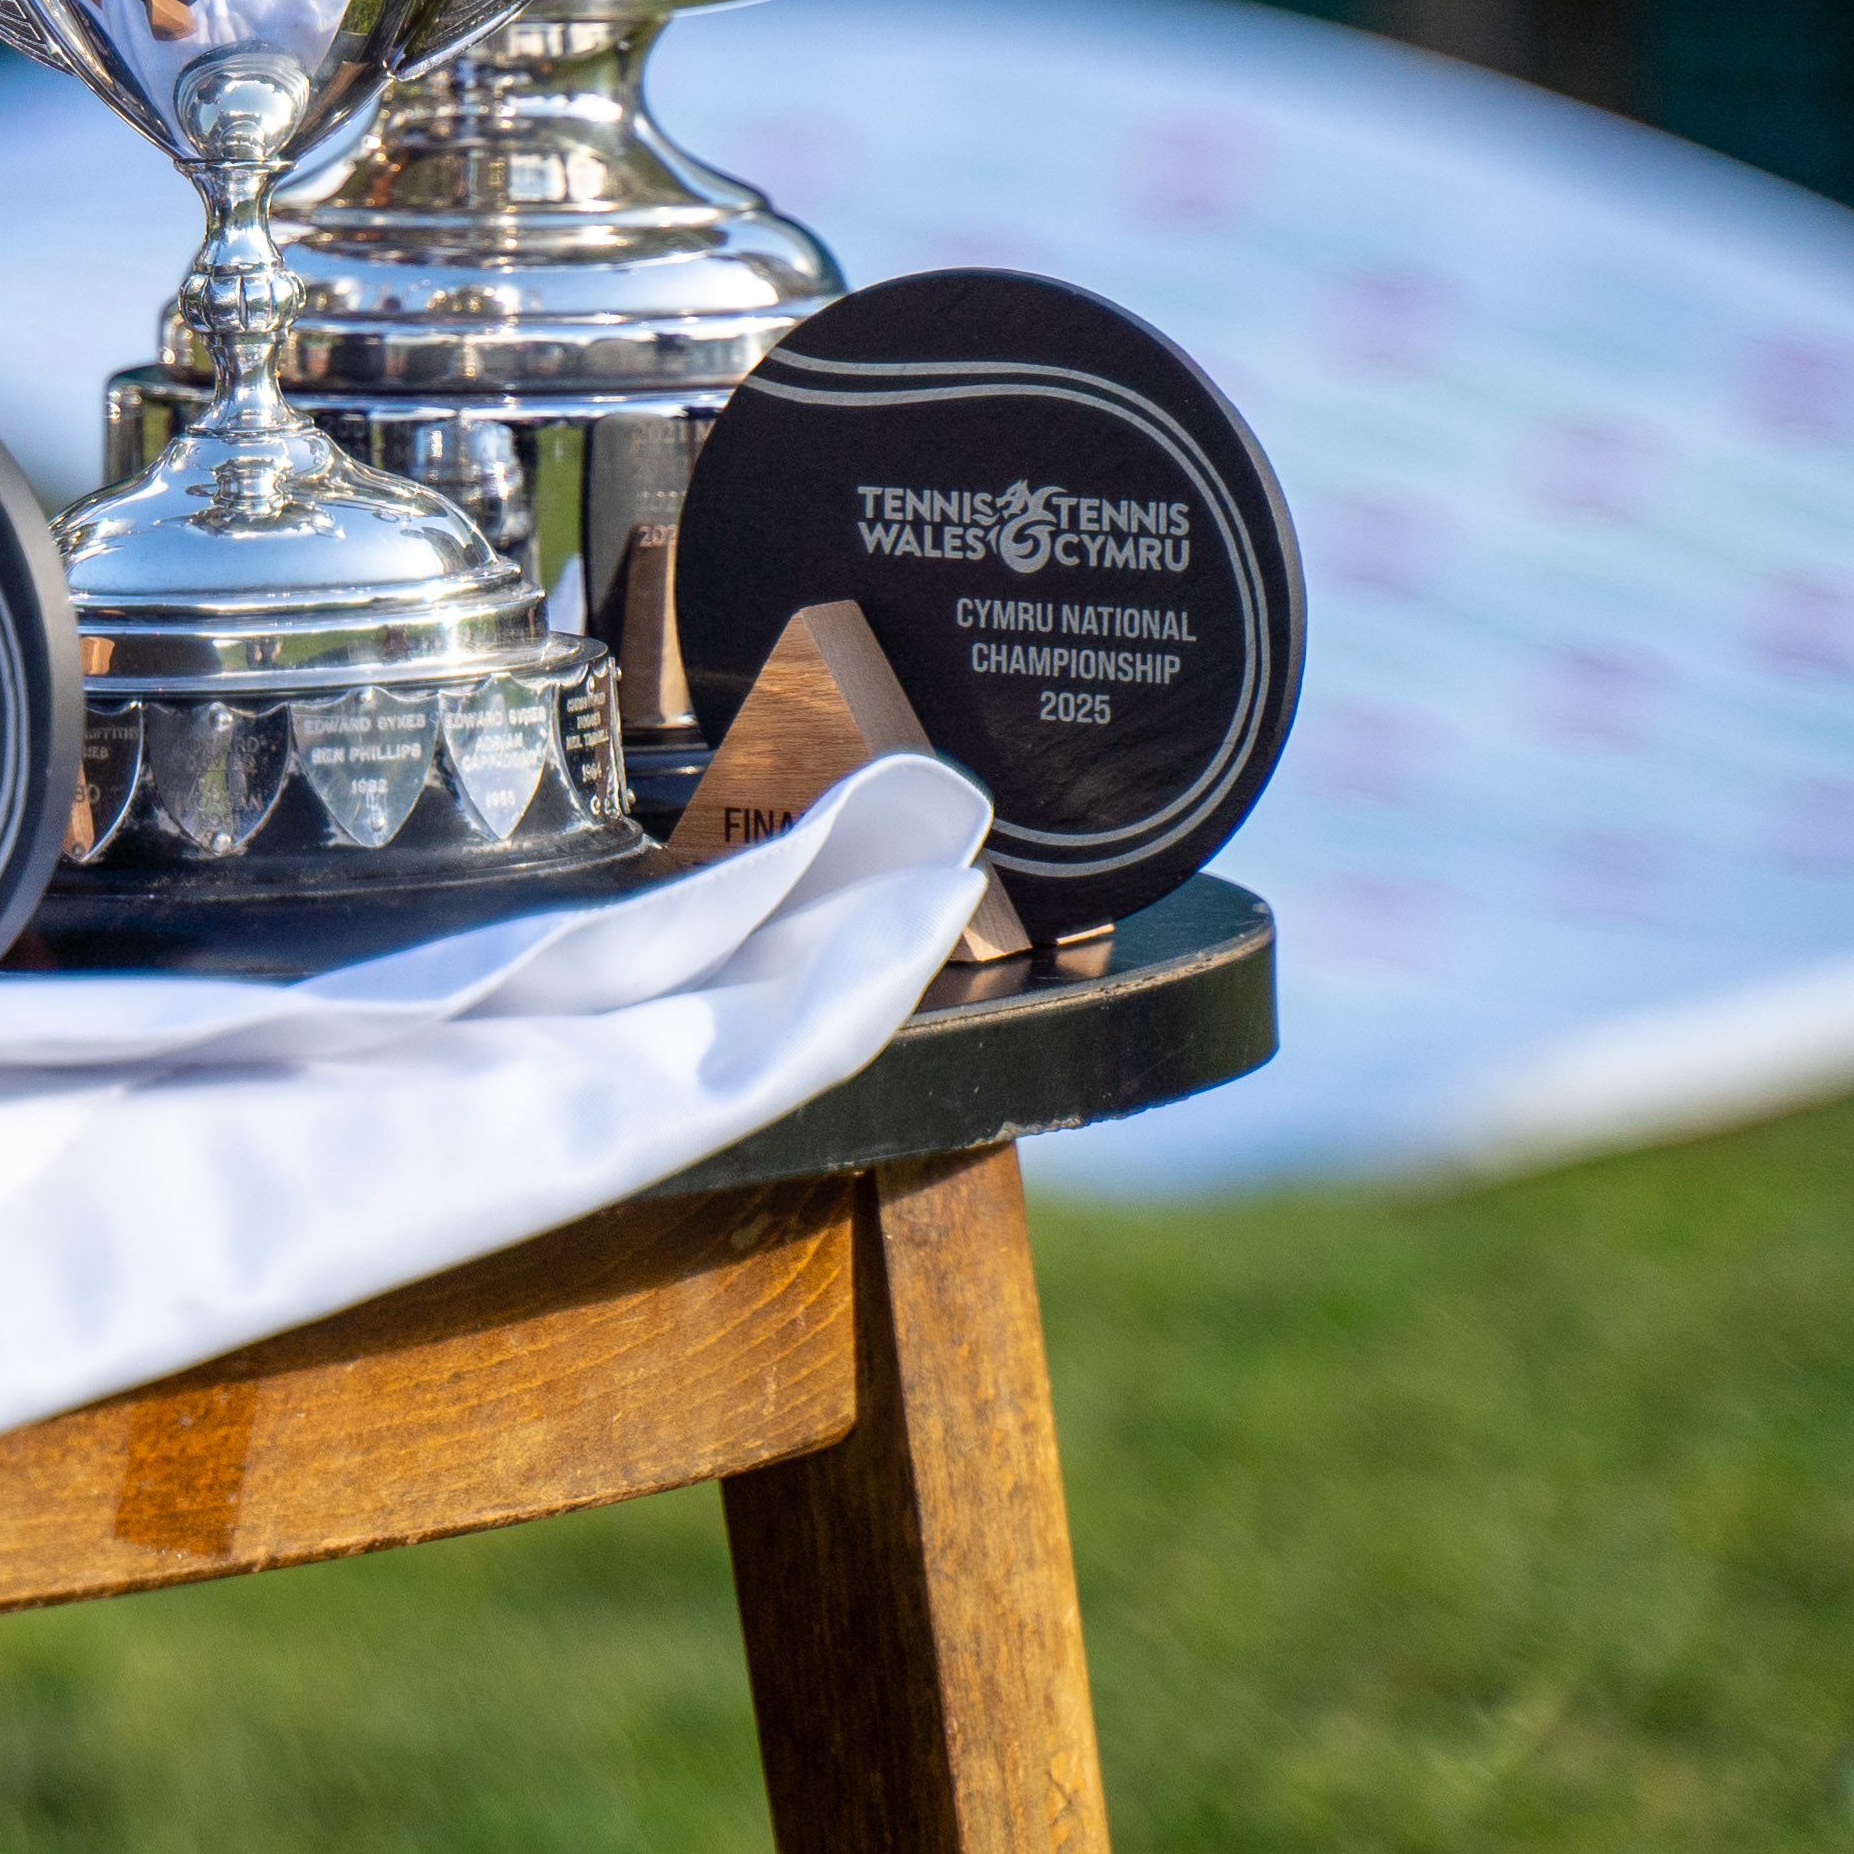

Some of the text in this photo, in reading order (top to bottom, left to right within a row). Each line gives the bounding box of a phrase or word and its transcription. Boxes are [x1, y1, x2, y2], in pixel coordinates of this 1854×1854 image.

[857, 486, 1190, 537] TENNIS TENNIS
[857, 521, 1190, 573] WALES CYMRU
[956, 597, 1198, 642] CYMRU NATIONAL
[972, 642, 1181, 685] CHAMPIONSHIP
[303, 713, 427, 734] EDWARD SYKES
[1040, 691, 1112, 725] 2025
[349, 743, 423, 762] PHILLIPS
[725, 806, 806, 844] FINA
